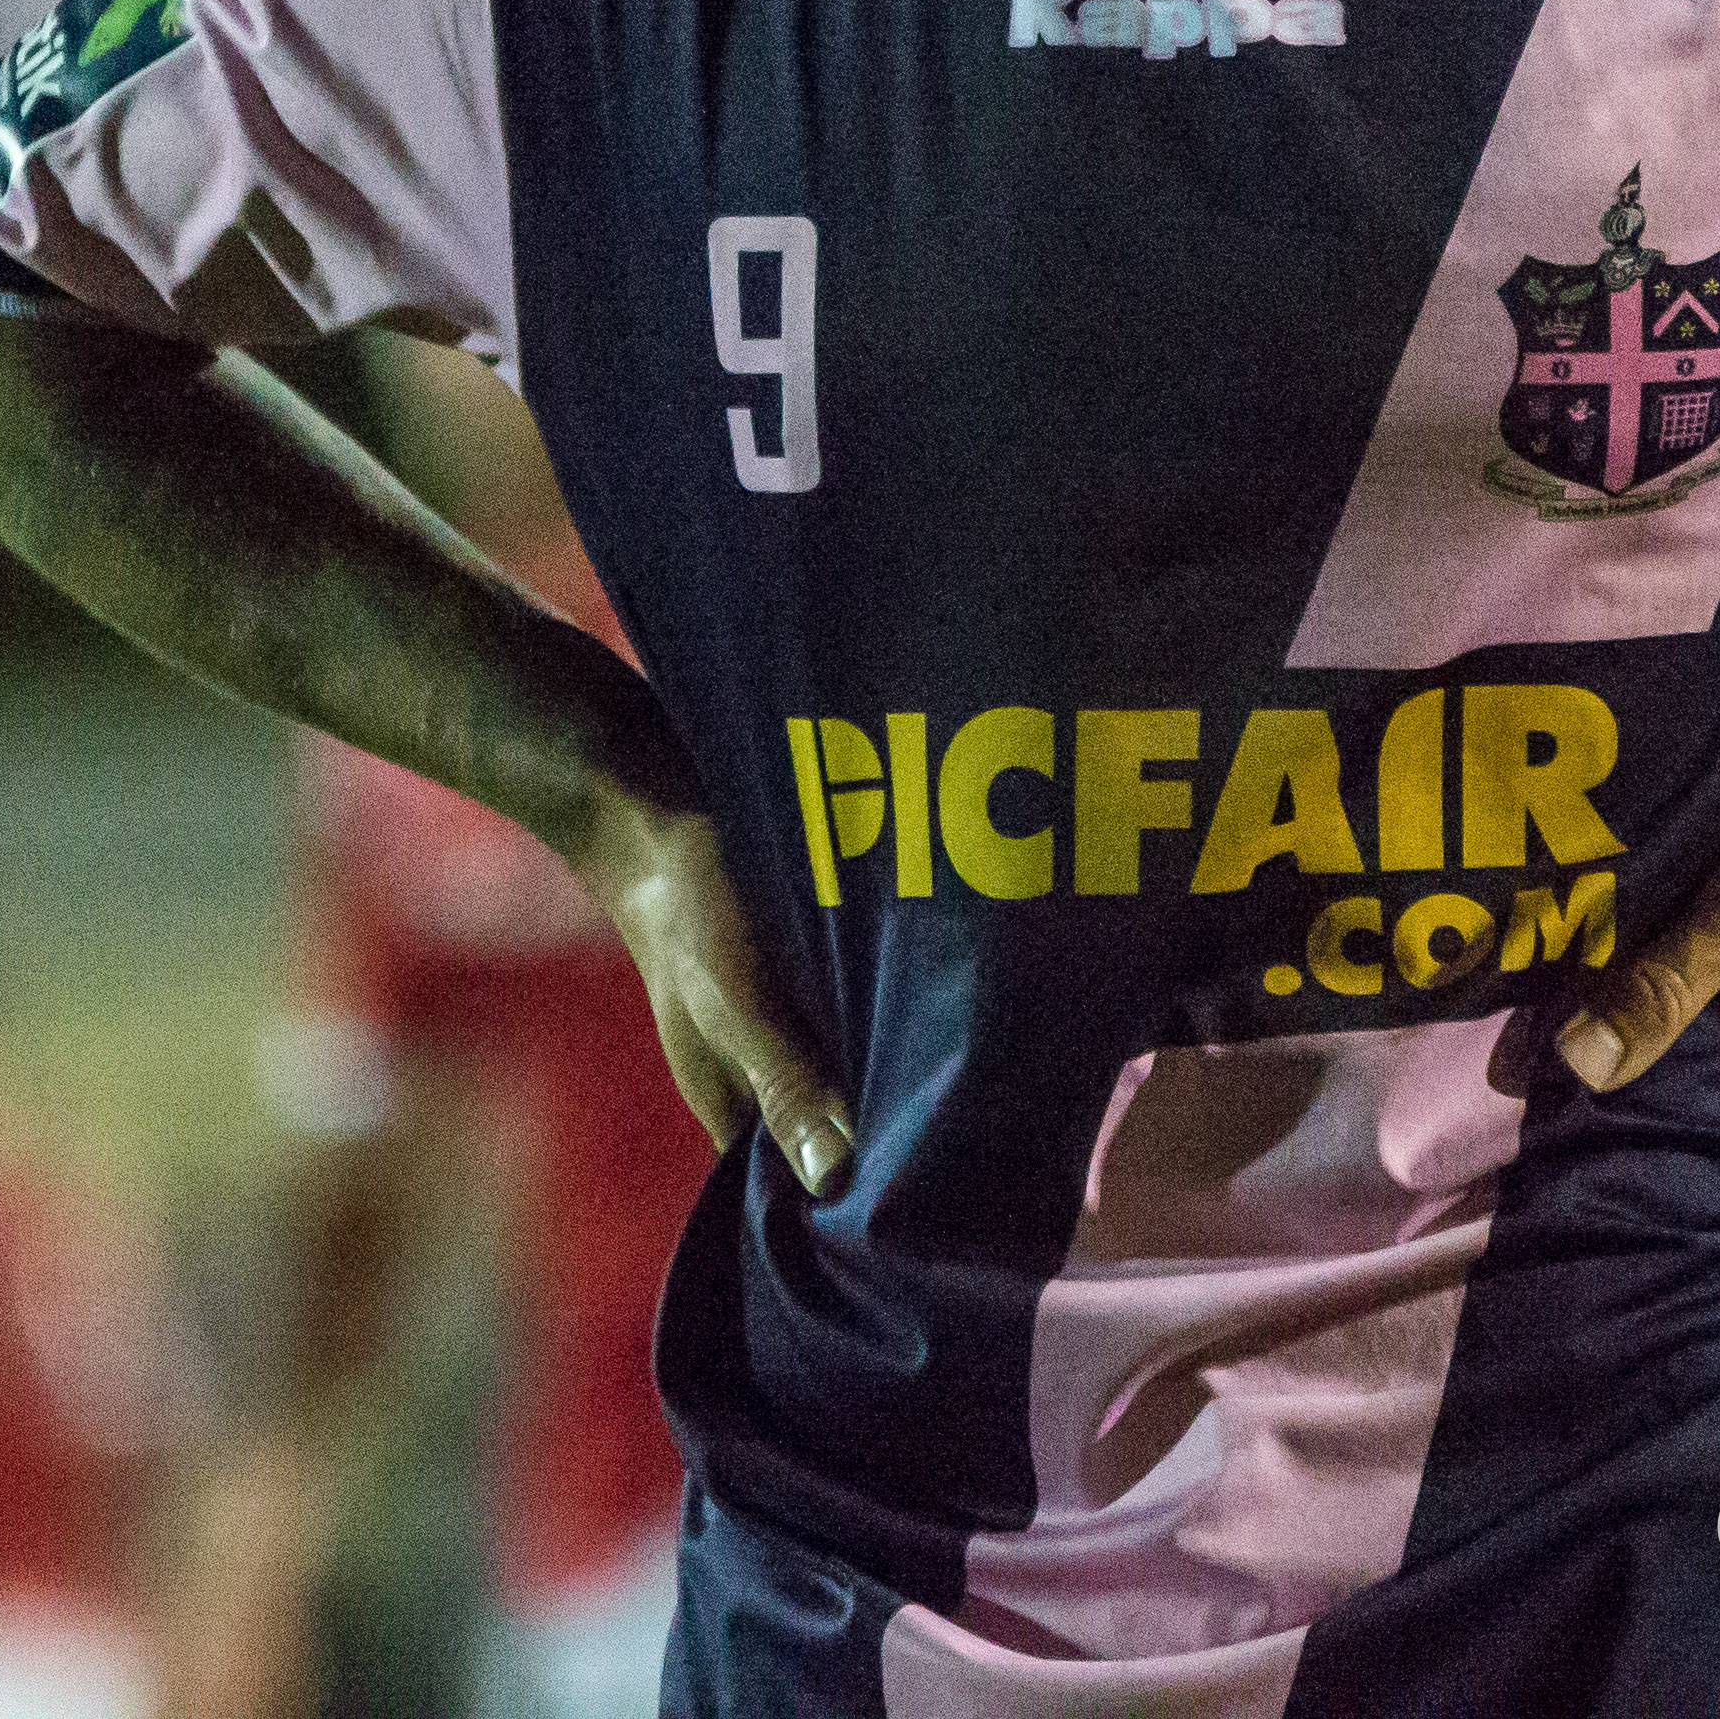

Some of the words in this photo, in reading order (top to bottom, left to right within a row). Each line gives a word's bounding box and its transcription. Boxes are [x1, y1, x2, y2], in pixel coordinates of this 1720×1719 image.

[17, 12, 68, 116] tik
[707, 216, 821, 493] 9
[786, 684, 1627, 907] PICFAIR
[1262, 872, 1617, 996] .COM
